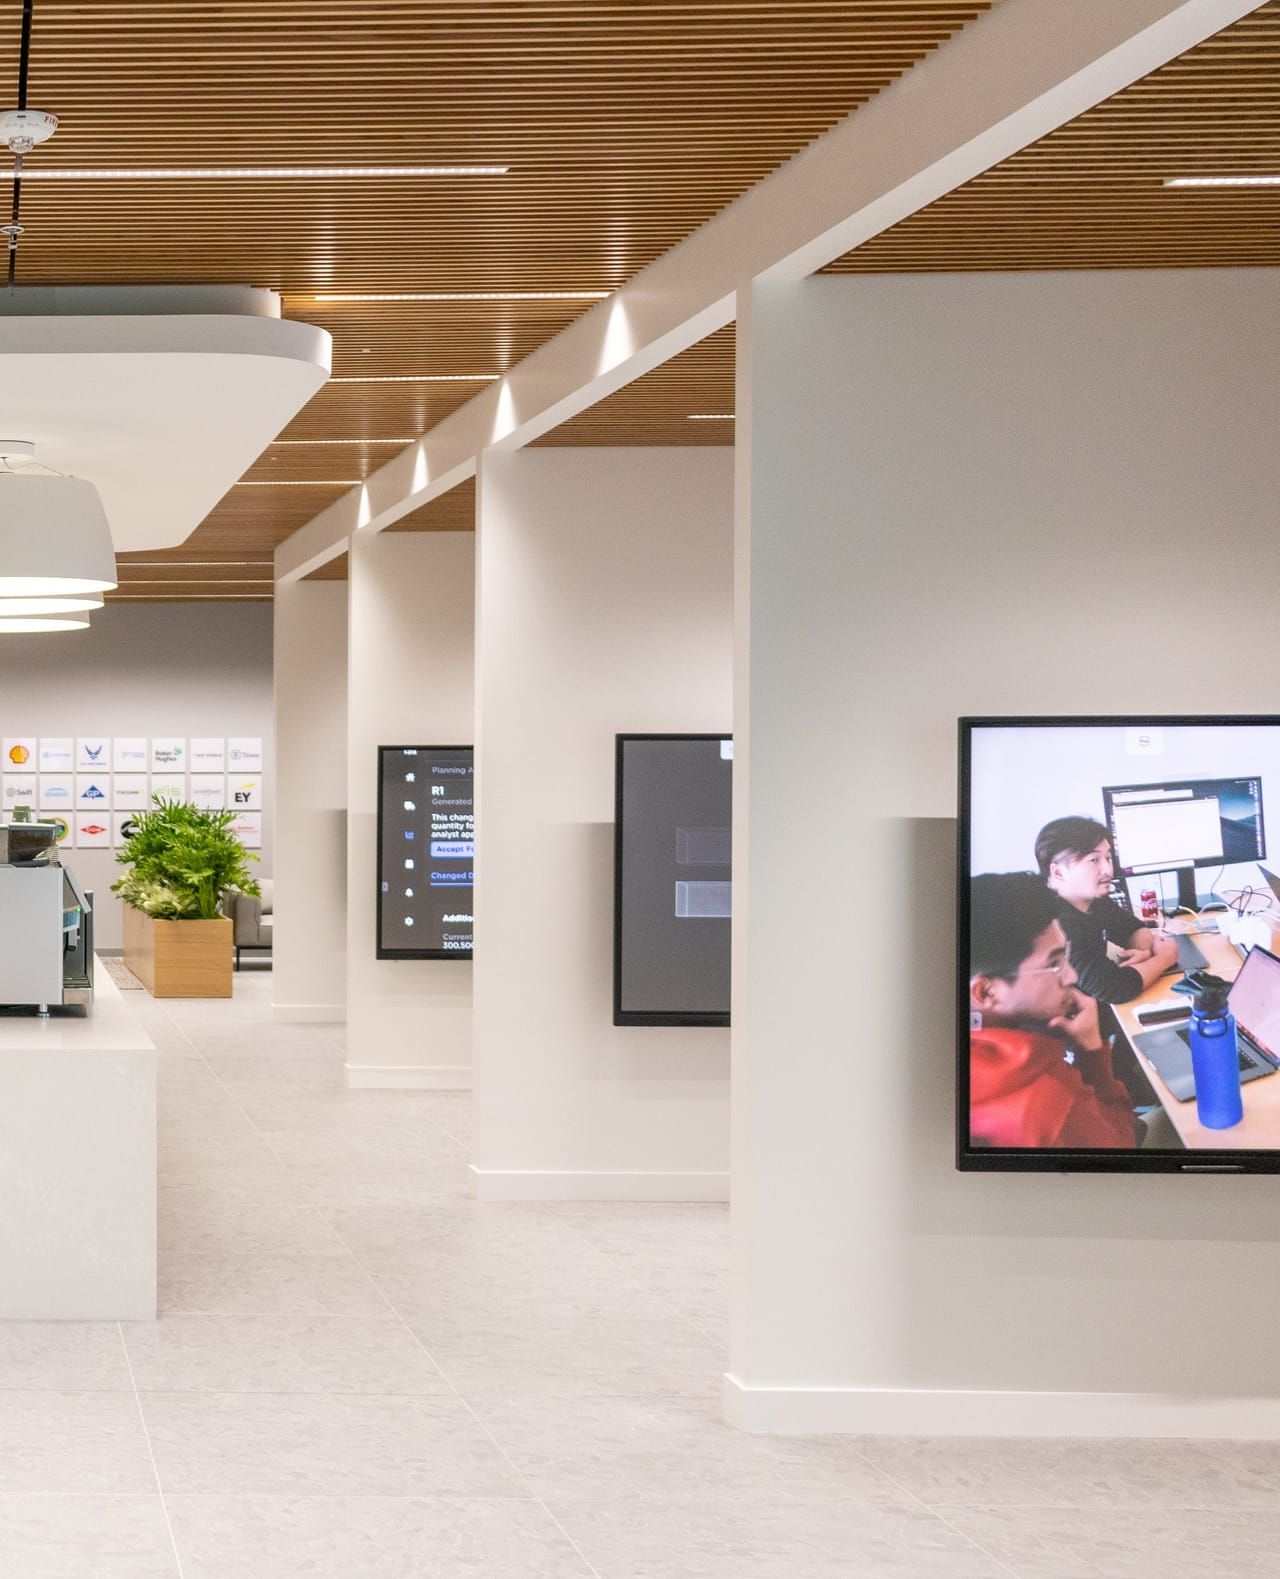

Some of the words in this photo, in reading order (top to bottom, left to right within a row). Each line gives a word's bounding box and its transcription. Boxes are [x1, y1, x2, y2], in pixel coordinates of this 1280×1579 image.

[432, 766, 466, 775] Planning
[431, 786, 444, 796] R1
[234, 792, 251, 802] EY
[431, 822, 465, 831] quantity
[431, 831, 460, 839] analyst
[437, 845, 463, 853] Accept
[431, 872, 466, 880] Changed
[442, 933, 472, 941] Current
